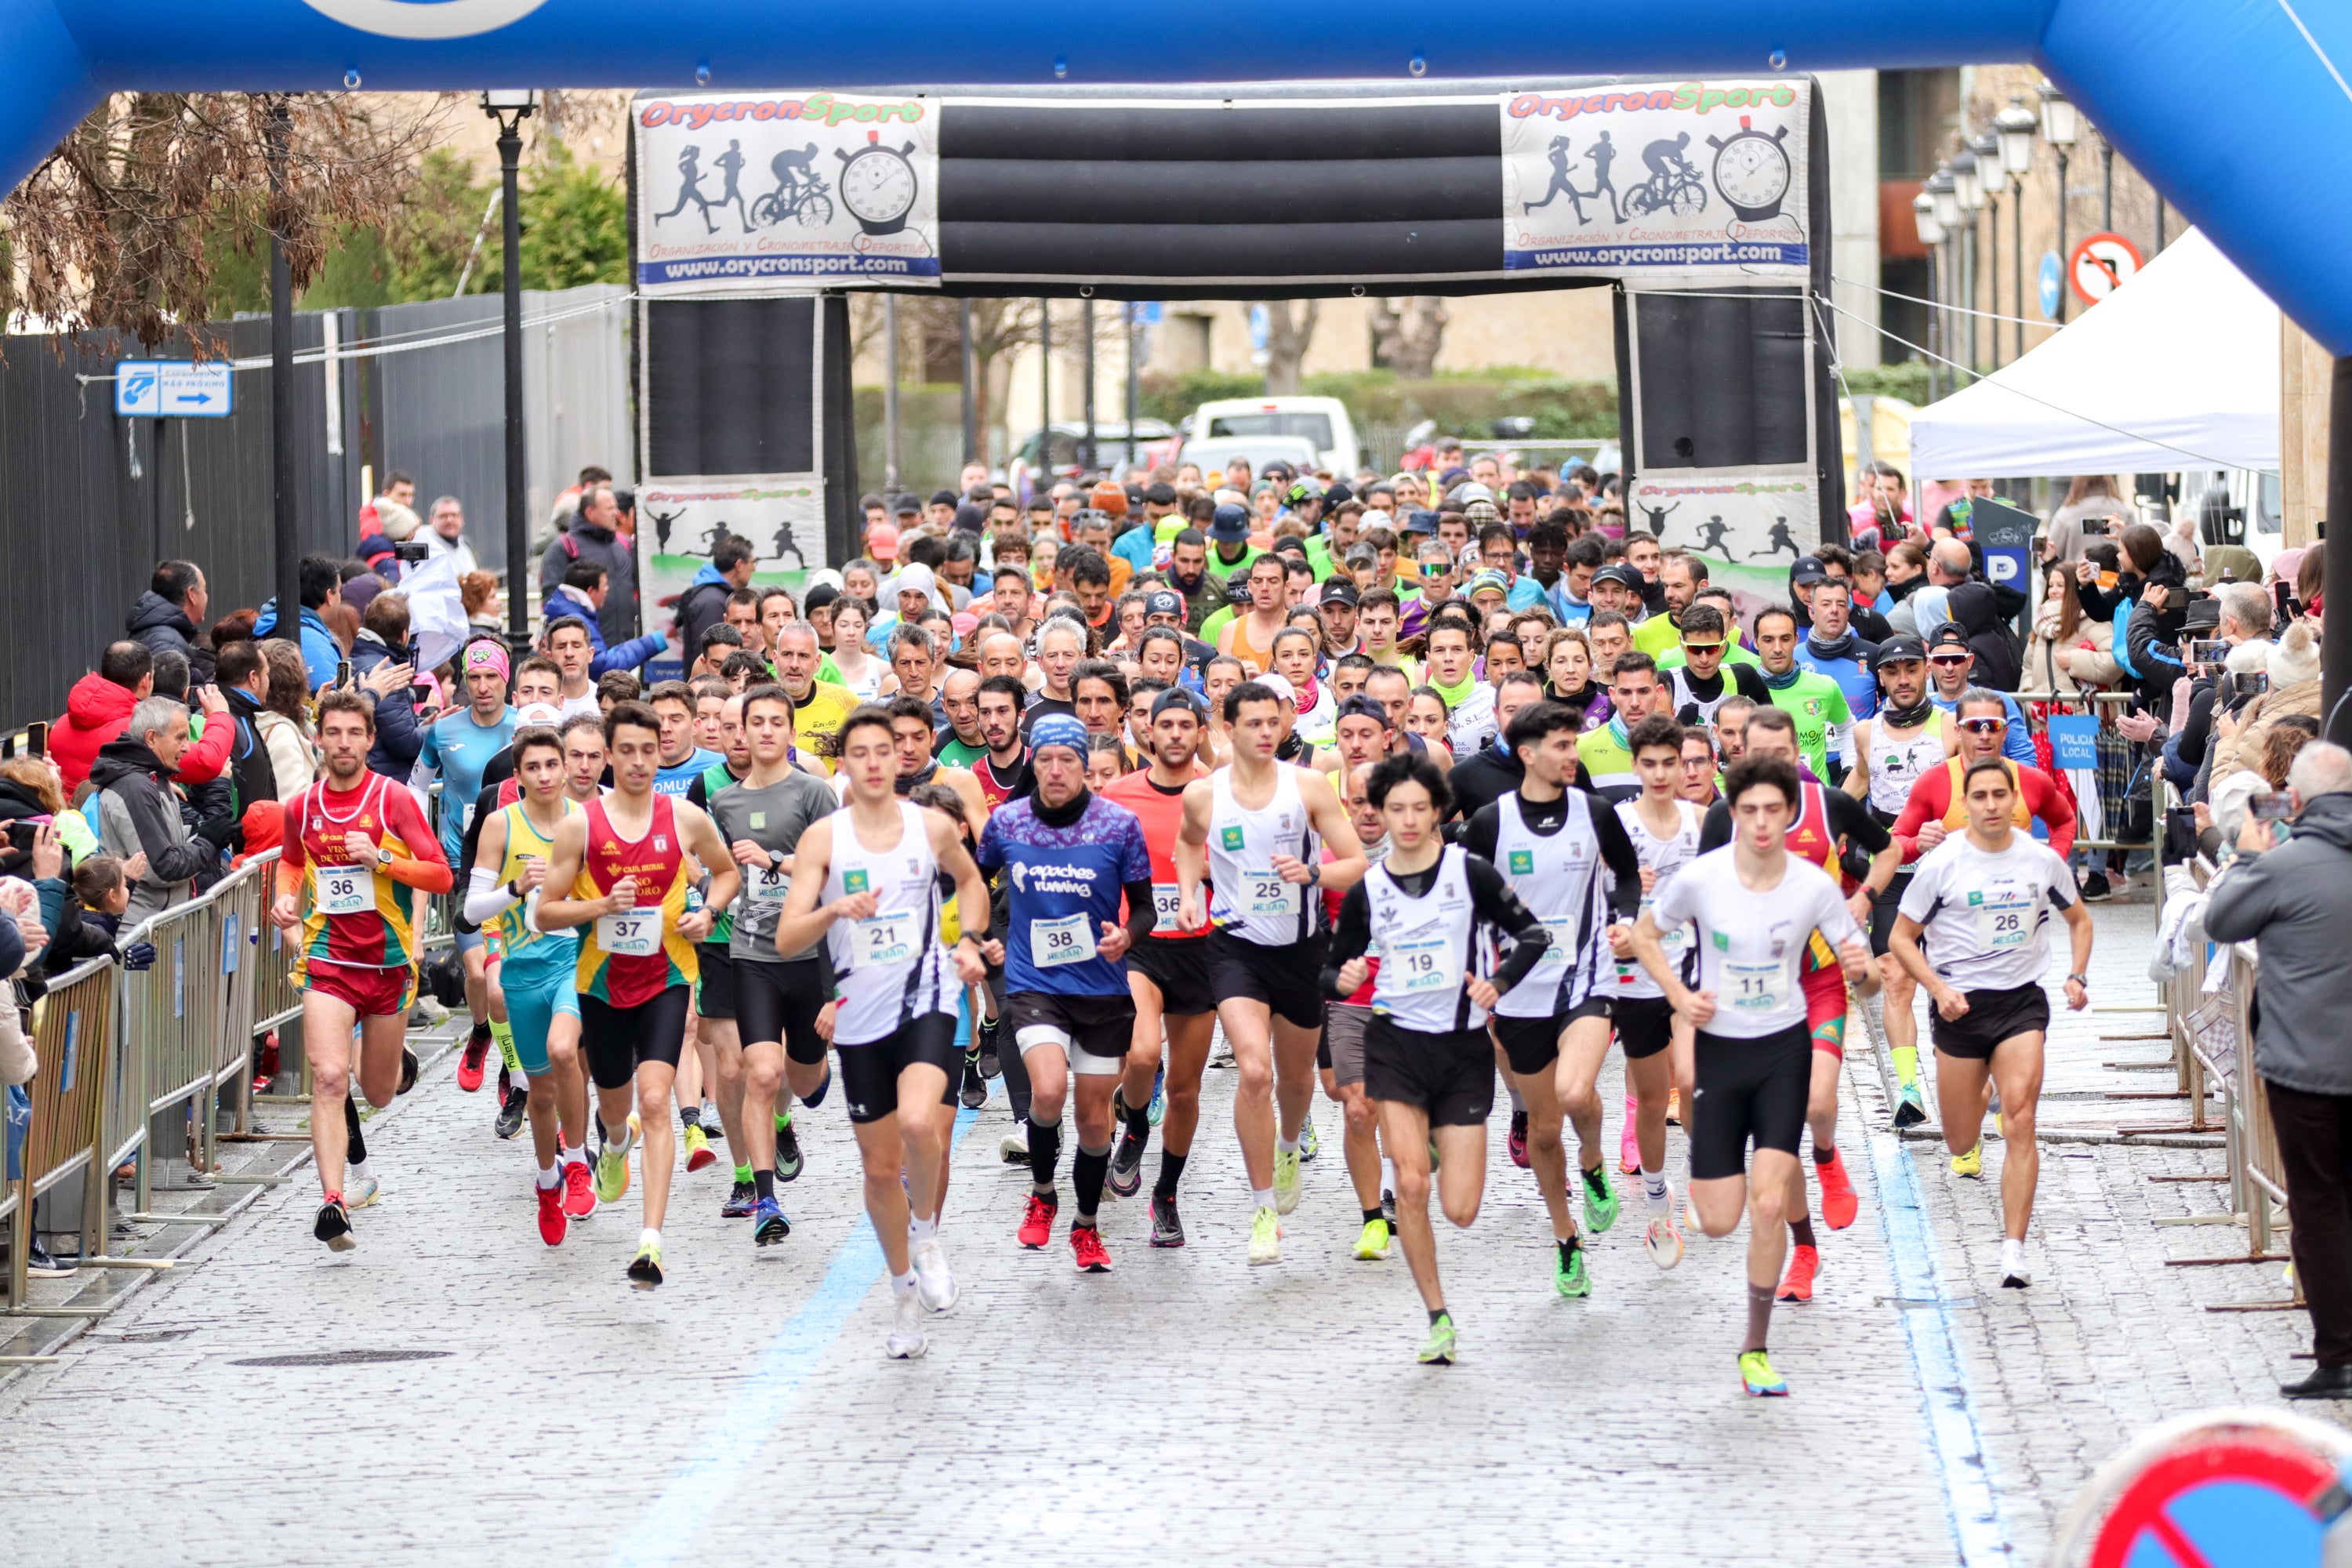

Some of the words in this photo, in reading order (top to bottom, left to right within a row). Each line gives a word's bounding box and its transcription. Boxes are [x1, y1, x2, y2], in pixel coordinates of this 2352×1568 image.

[1508, 81, 1796, 121] OrycronSport
[641, 93, 925, 130] OrycronSport
[1534, 242, 1782, 266] www.orycronsport.com
[665, 257, 908, 279] www.orycronsport.com
[2060, 733, 2094, 745] POLICIA
[2062, 746, 2092, 758] LOCAL
[653, 779, 693, 793] OMUS
[327, 845, 345, 854] VIN
[320, 854, 333, 862] DE
[641, 862, 666, 872] RURAL
[1029, 863, 1097, 880] apaches
[760, 869, 779, 885] 20
[331, 879, 353, 895] 36
[636, 885, 661, 896] ORO
[1034, 880, 1091, 898] running
[1255, 882, 1280, 898] 25
[329, 898, 359, 908] HESAN
[1252, 902, 1285, 911] HESAN
[615, 921, 641, 937] 37
[1995, 914, 2018, 931] 26
[870, 926, 895, 945] 21
[1047, 931, 1073, 947] 38
[1992, 935, 2023, 944] HESAN
[611, 941, 644, 950] HESAN
[1047, 949, 1080, 960] HESAN
[1407, 953, 1432, 971] 19
[1740, 978, 1763, 993] 11
